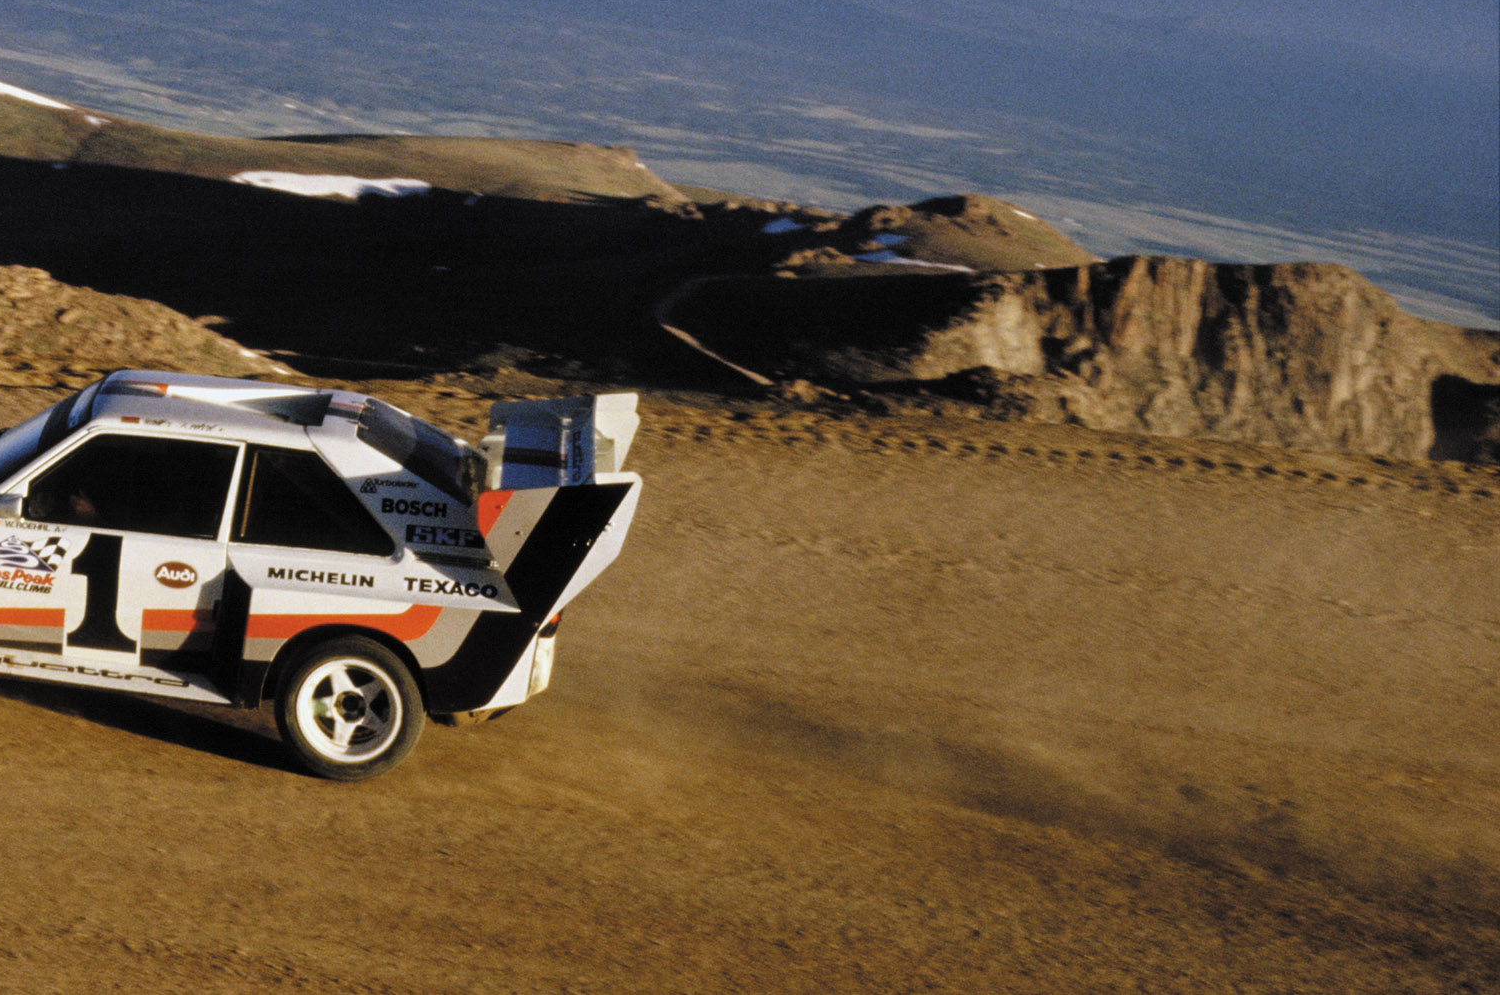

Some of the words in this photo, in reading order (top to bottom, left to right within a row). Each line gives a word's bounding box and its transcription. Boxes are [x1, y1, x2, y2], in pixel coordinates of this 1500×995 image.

[381, 498, 448, 518] BOSCH
[412, 527, 479, 547] SKF
[11, 569, 56, 586] Peak
[157, 566, 195, 582] Audi
[267, 567, 374, 588] MICHELIN
[66, 532, 137, 654] 1
[403, 577, 498, 599] TEXACO
